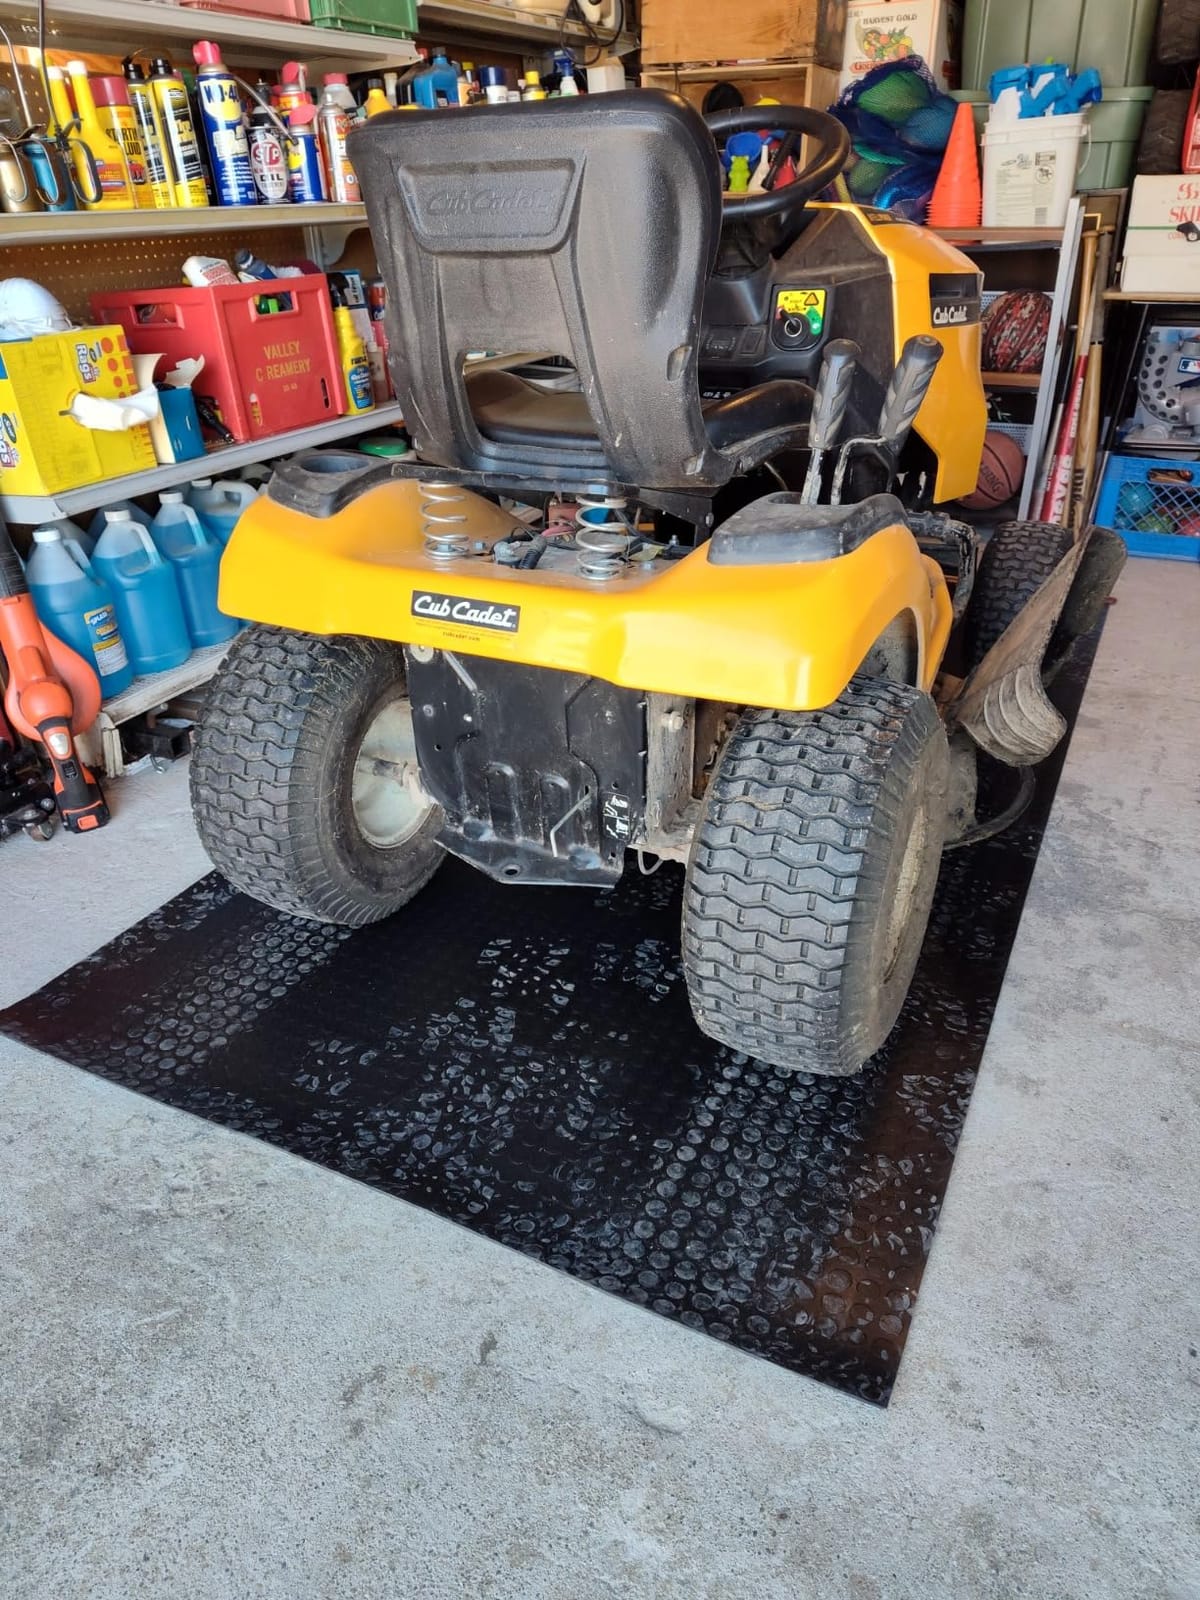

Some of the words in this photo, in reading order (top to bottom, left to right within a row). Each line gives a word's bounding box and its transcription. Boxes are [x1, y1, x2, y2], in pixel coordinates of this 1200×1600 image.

[863, 15, 894, 25] HARVEST
[896, 14, 918, 22] GOLD
[255, 143, 280, 164] STP
[933, 306, 949, 324] Cub
[949, 305, 967, 323] Cadet
[263, 341, 300, 360] VALLEY
[76, 344, 93, 381] Rags
[414, 595, 451, 616] Cub
[452, 601, 517, 628] Cadet
